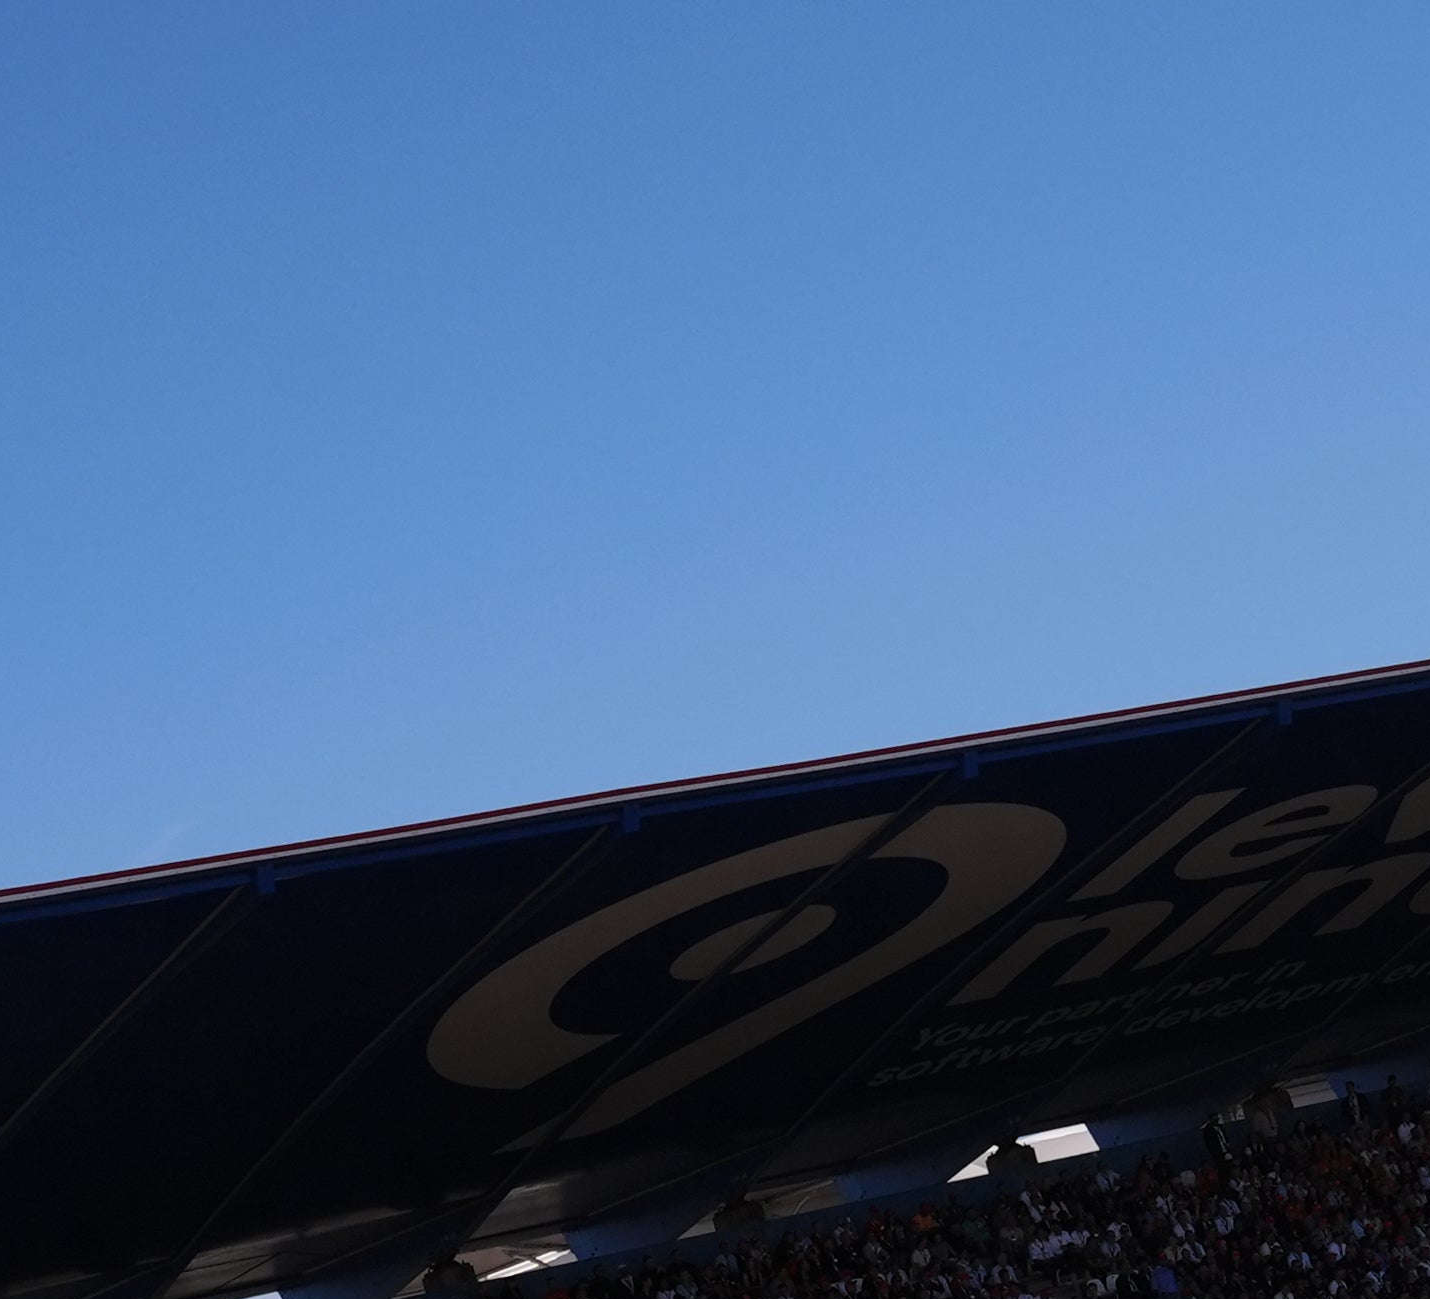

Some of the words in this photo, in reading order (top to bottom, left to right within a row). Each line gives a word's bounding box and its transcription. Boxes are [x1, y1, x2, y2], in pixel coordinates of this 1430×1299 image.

[911, 1015, 1030, 1051] Your
[1253, 959, 1307, 985] in
[867, 1025, 1108, 1087] software
